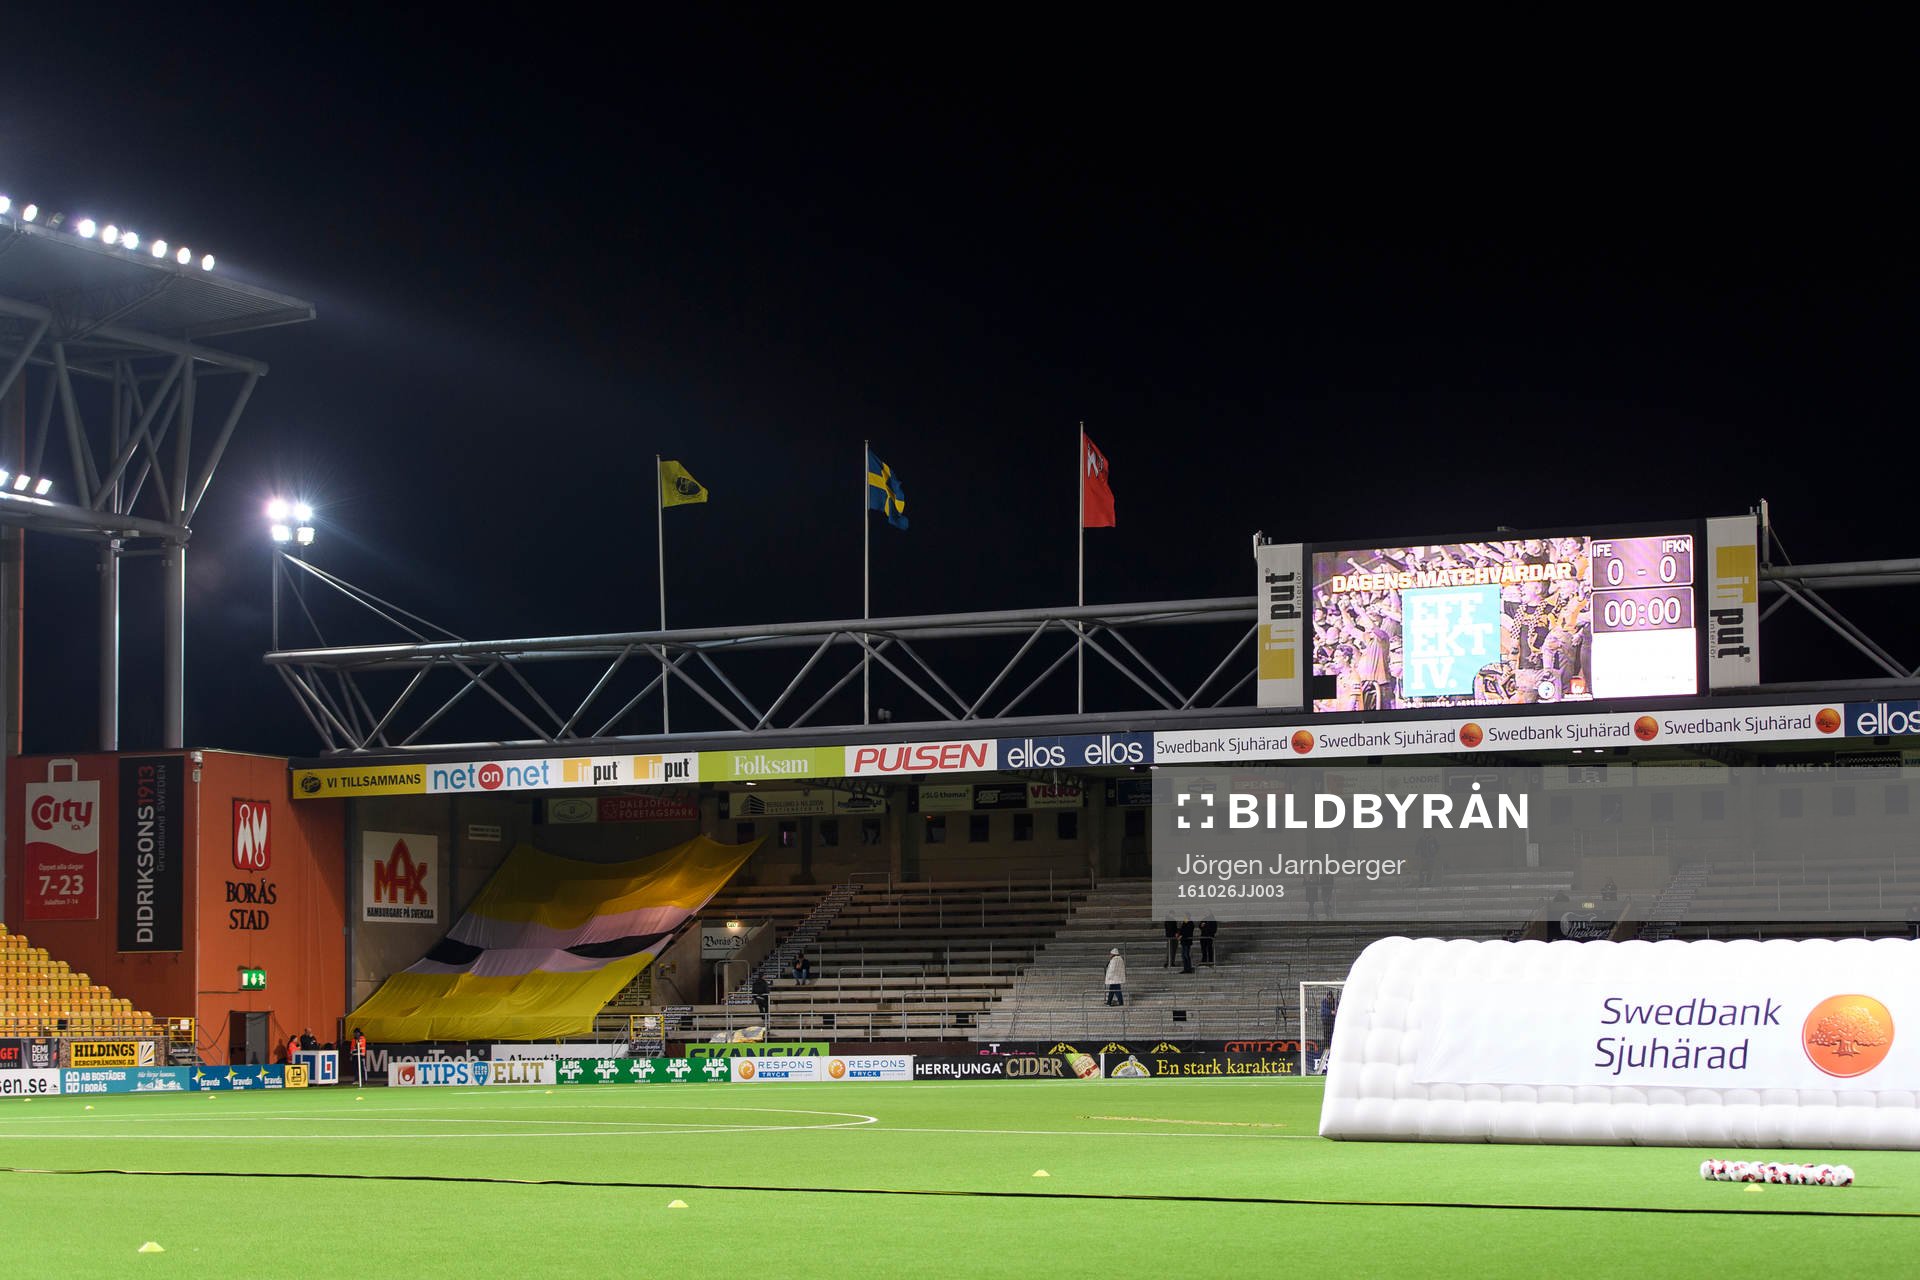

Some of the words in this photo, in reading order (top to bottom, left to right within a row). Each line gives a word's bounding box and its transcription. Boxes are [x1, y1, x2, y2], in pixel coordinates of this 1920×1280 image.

[1593, 543, 1612, 558] IFE
[1662, 538, 1692, 554] IFKN
[1332, 573, 1410, 593] DAGENS
[1415, 562, 1572, 588] MATCHVÄRDAR
[1607, 559, 1624, 585] 0
[1660, 556, 1676, 583] 0
[1604, 597, 1682, 628] 00:00
[1411, 626, 1492, 656] EKT
[1664, 718, 1742, 736] Swedbank
[1745, 714, 1811, 735] Sjuhärad
[1857, 703, 1920, 735] ellos
[1319, 732, 1391, 749] Swedbank
[1394, 729, 1456, 748] Sjuhärad
[1488, 725, 1562, 742] Swedbank
[1566, 722, 1630, 741] Sjuhärad
[1007, 739, 1066, 768] ellos
[1084, 736, 1144, 765] ellos
[1156, 738, 1225, 755] Swedbank
[1229, 736, 1288, 755] Sjuhärad
[734, 755, 809, 776] Folksam
[853, 743, 988, 773] PULSEN
[157, 765, 167, 812] SWEDEN
[327, 778, 338, 788] VI
[341, 773, 421, 787] TILLSAMMANS
[32, 795, 93, 830] City
[374, 838, 428, 904] MAX
[39, 874, 84, 896] 7-23
[226, 878, 277, 905] BORÅS
[229, 909, 270, 930] STAD
[367, 907, 401, 918] HAMBURGARE
[402, 905, 410, 918] PÅ
[411, 907, 434, 920] SVENSKA
[1600, 997, 1783, 1026] Swedbank
[0, 1047, 19, 1060] GET
[74, 1044, 135, 1057] HILDINGS
[1594, 1037, 1749, 1075] Sjuhärad
[493, 1063, 544, 1083] ELIT
[563, 1060, 579, 1069] LBC
[598, 1060, 615, 1069] LBC
[634, 1060, 651, 1068] LBC
[670, 1059, 687, 1068] LBC
[706, 1059, 725, 1067] LBC
[758, 1060, 813, 1069] RESPONS
[849, 1060, 906, 1068] RESPONS
[916, 1062, 1001, 1078] HERRLJUNGA
[1006, 1057, 1064, 1077] CIDER
[1156, 1059, 1180, 1075] En
[1183, 1059, 1221, 1075] stark
[1225, 1057, 1294, 1075] karaktär
[81, 1072, 90, 1080] AB
[92, 1070, 126, 1080] BOSTÄDER
[418, 1063, 469, 1084] TIPS
[0, 1078, 47, 1094] en.se
[85, 1081, 107, 1092] BORÅS
